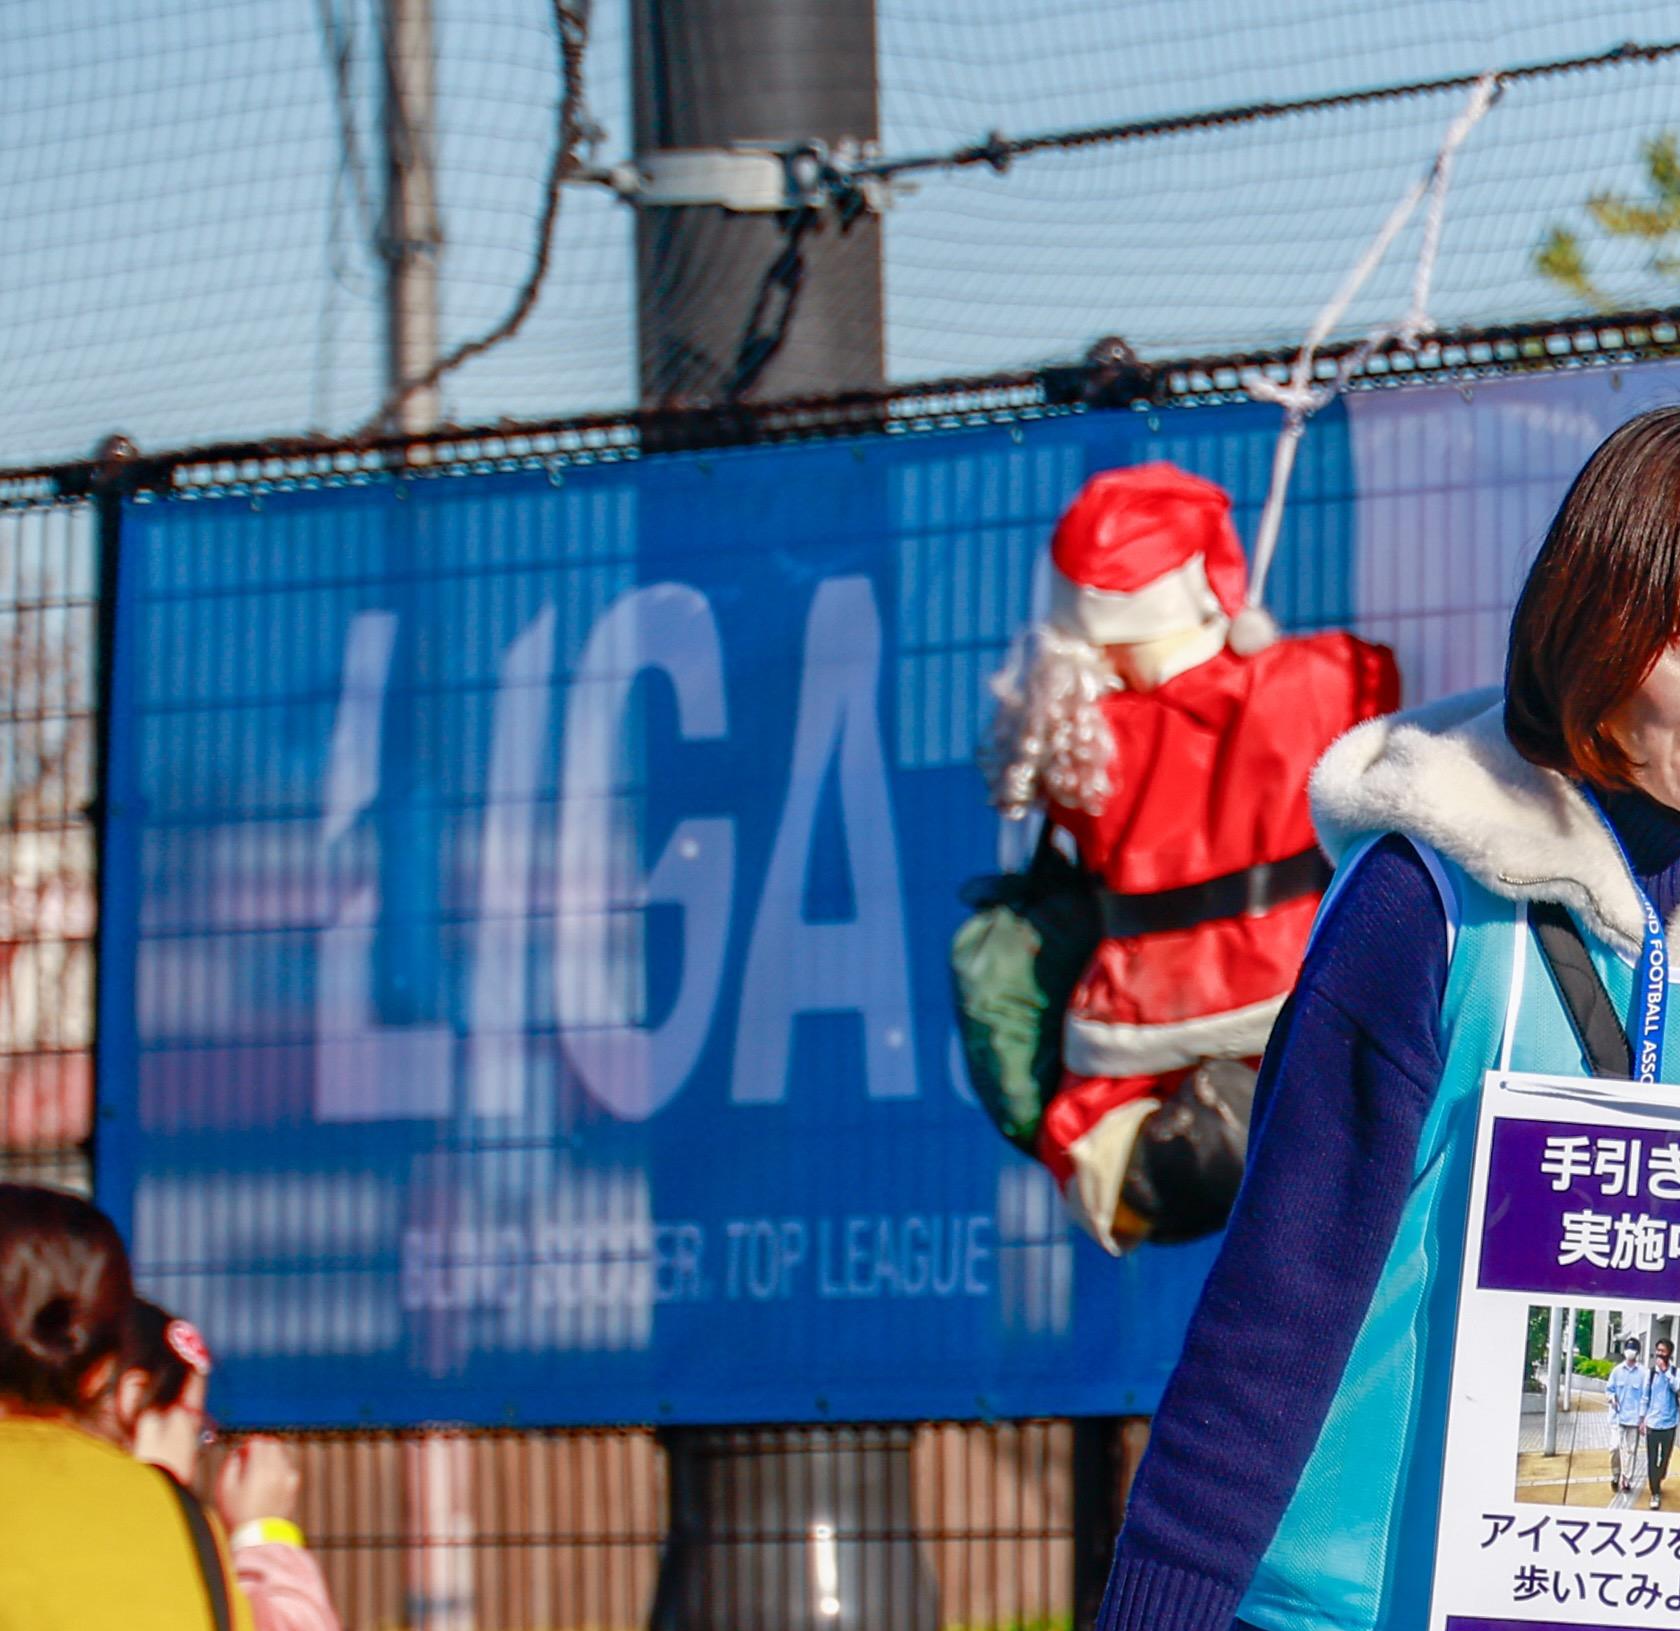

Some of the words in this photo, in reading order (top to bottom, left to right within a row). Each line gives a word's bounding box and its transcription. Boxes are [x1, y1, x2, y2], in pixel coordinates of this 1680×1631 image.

[313, 576, 980, 1122] LIGA
[1644, 939, 1663, 1035] FOOTBALL
[726, 1221, 807, 1298] TOP
[818, 1215, 993, 1297] LEAGUE
